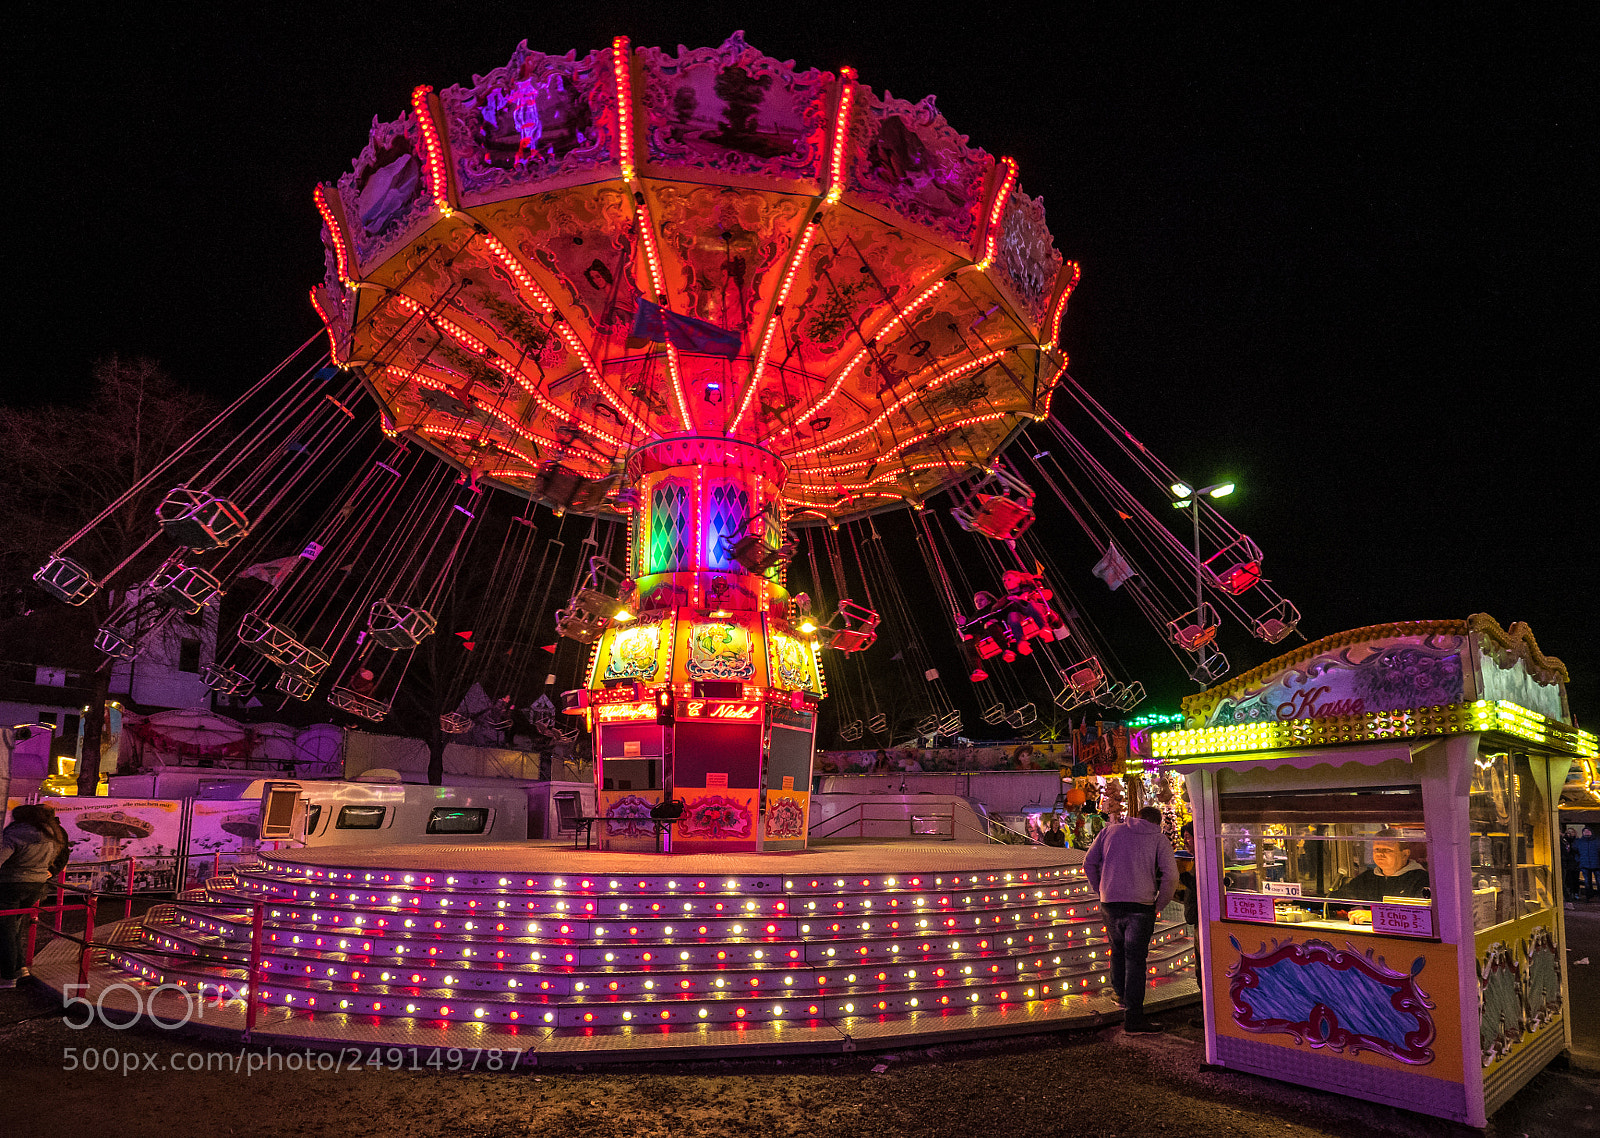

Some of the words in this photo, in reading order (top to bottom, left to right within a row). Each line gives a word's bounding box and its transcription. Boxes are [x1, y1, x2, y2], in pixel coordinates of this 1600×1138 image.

[1276, 686, 1365, 720] Kasse
[710, 704, 759, 719] Nickel
[1264, 883, 1271, 891] 4
[1239, 900, 1255, 908] Chip
[1240, 907, 1257, 915] Chip
[1387, 912, 1407, 920] Chip
[1388, 919, 1409, 928] Chip
